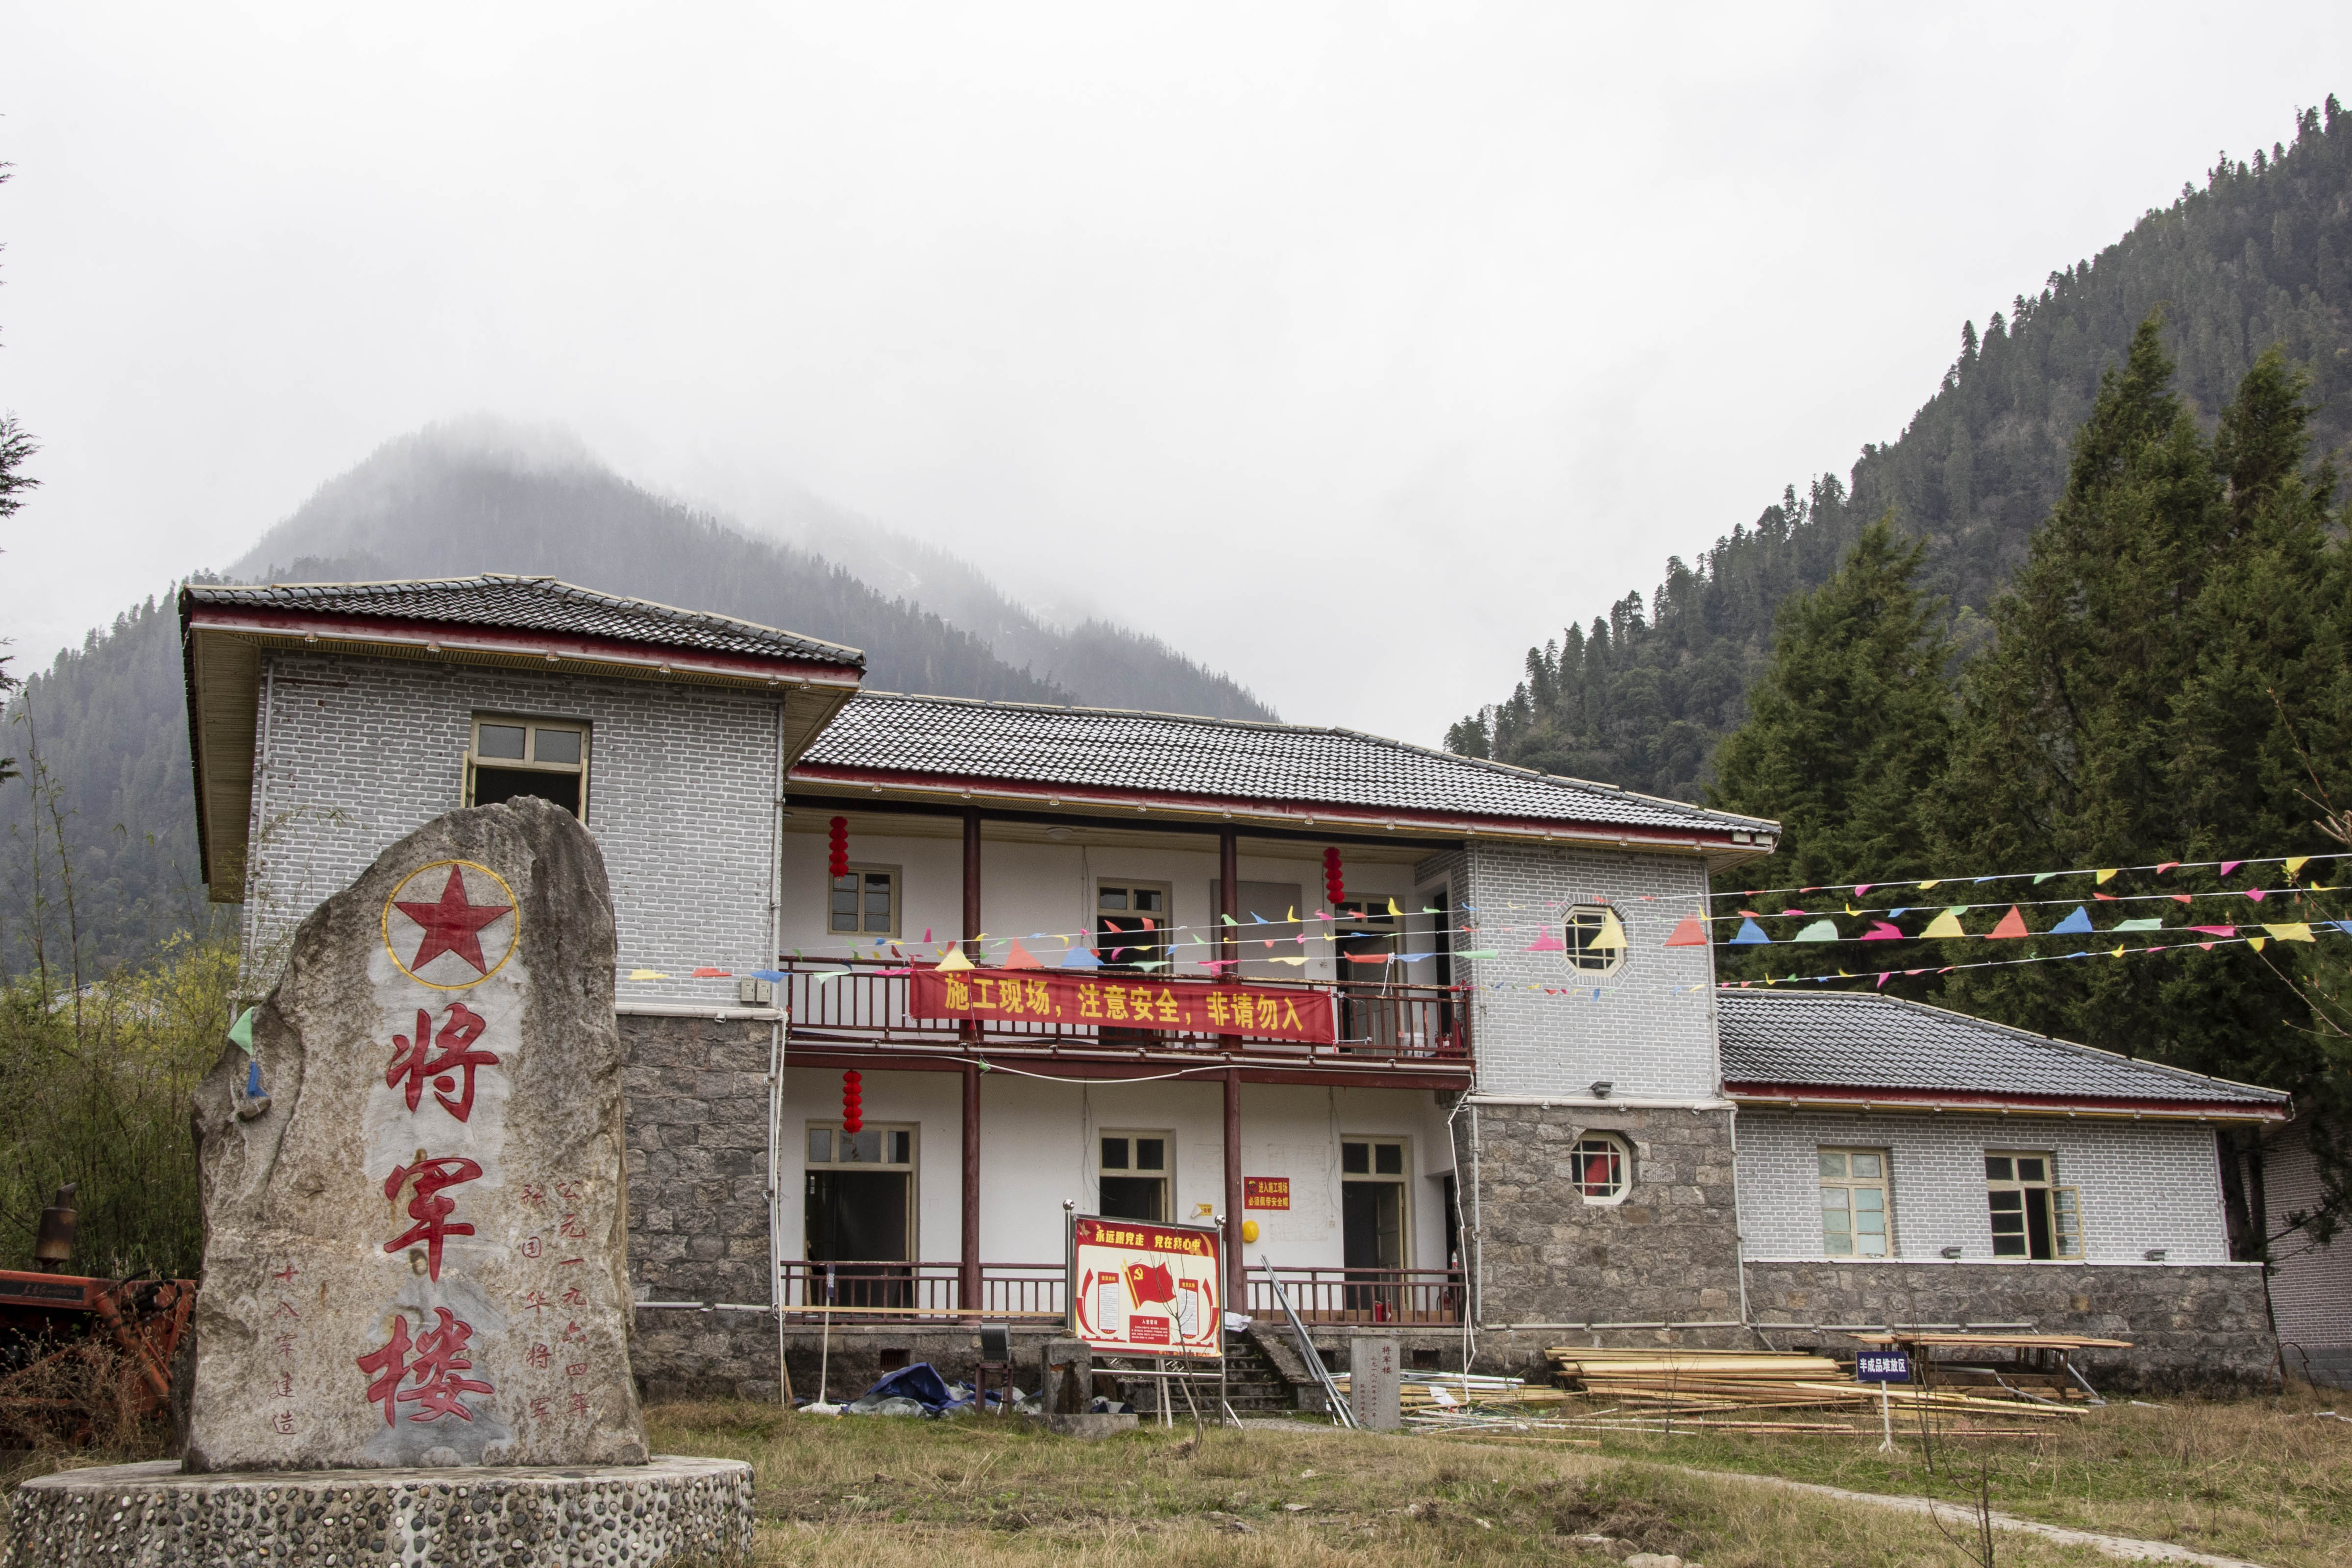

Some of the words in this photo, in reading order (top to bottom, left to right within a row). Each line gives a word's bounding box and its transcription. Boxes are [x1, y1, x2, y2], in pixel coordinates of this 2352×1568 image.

[357, 1003, 498, 1426] 将军楼
[1258, 1181, 1288, 1193] 进入施工现场
[1096, 1229, 1144, 1246] 永远跟党走
[1154, 1235, 1200, 1251] 党在我心中
[521, 1181, 552, 1425] 张国华将军
[556, 1180, 590, 1419] 公元一九六四年
[269, 1266, 299, 1434] 十八军建造
[1382, 1346, 1392, 1374] 将军楼
[1860, 1358, 1906, 1372] 半成品堆放区
